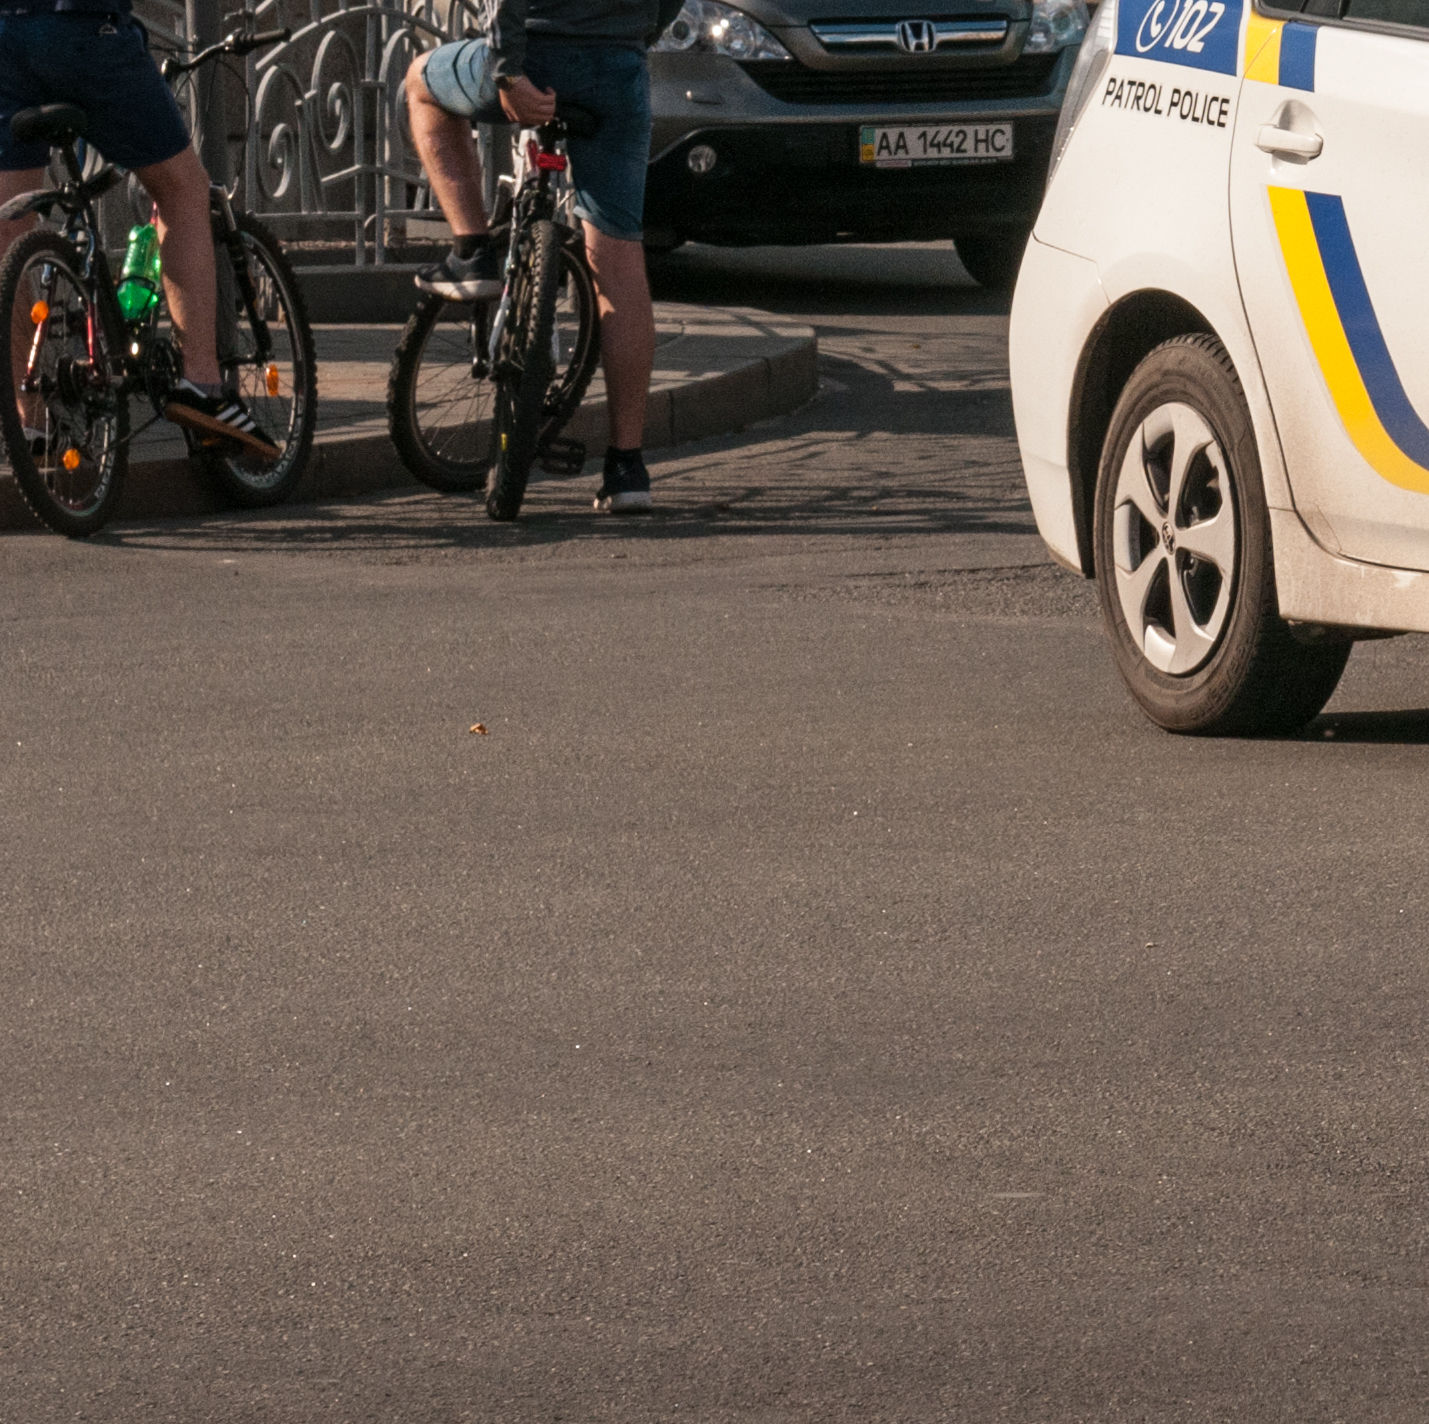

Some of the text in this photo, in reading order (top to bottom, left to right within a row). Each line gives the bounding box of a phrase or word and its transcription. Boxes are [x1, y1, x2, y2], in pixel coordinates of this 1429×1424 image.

[1101, 77, 1230, 128] PATROL POLICE
[877, 128, 1006, 156] AA 1442 HC
